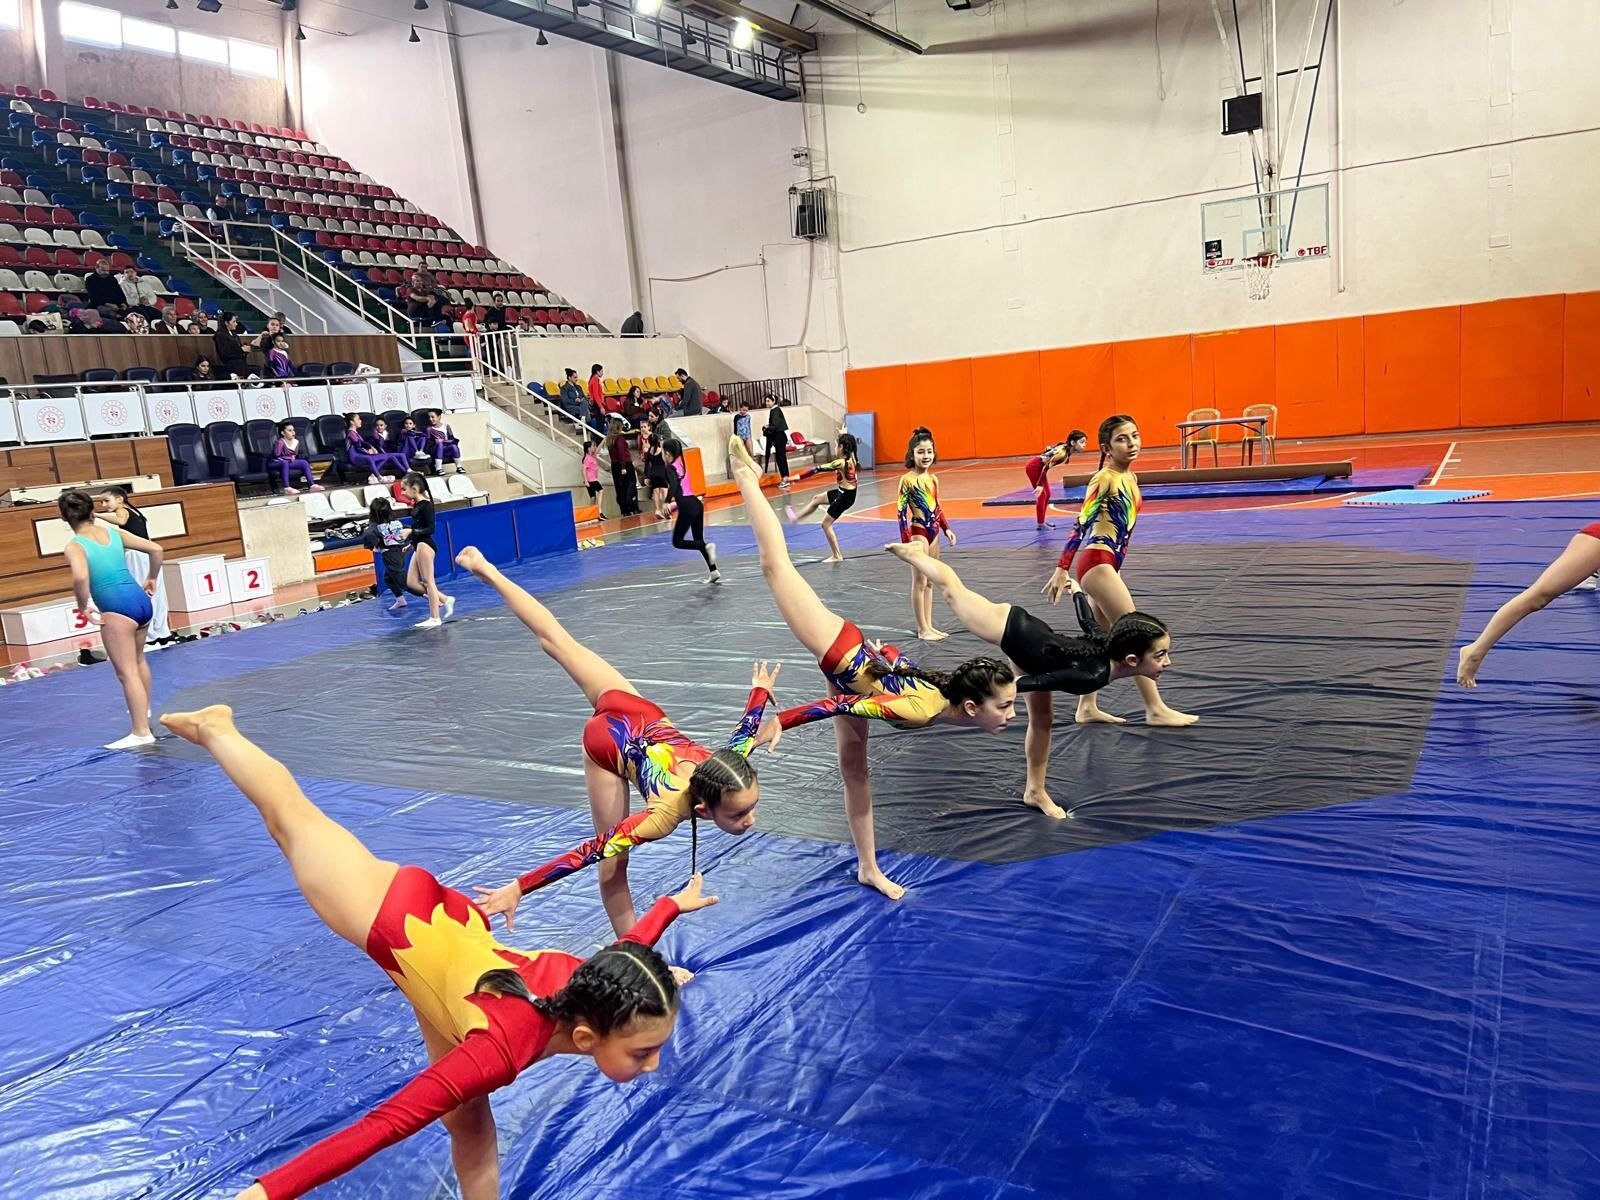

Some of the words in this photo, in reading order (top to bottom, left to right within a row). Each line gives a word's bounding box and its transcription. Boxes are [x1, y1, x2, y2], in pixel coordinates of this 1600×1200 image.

[1307, 245, 1327, 256] TBF
[204, 573, 214, 592] 1
[247, 570, 260, 589] 2
[72, 608, 88, 628] 3
